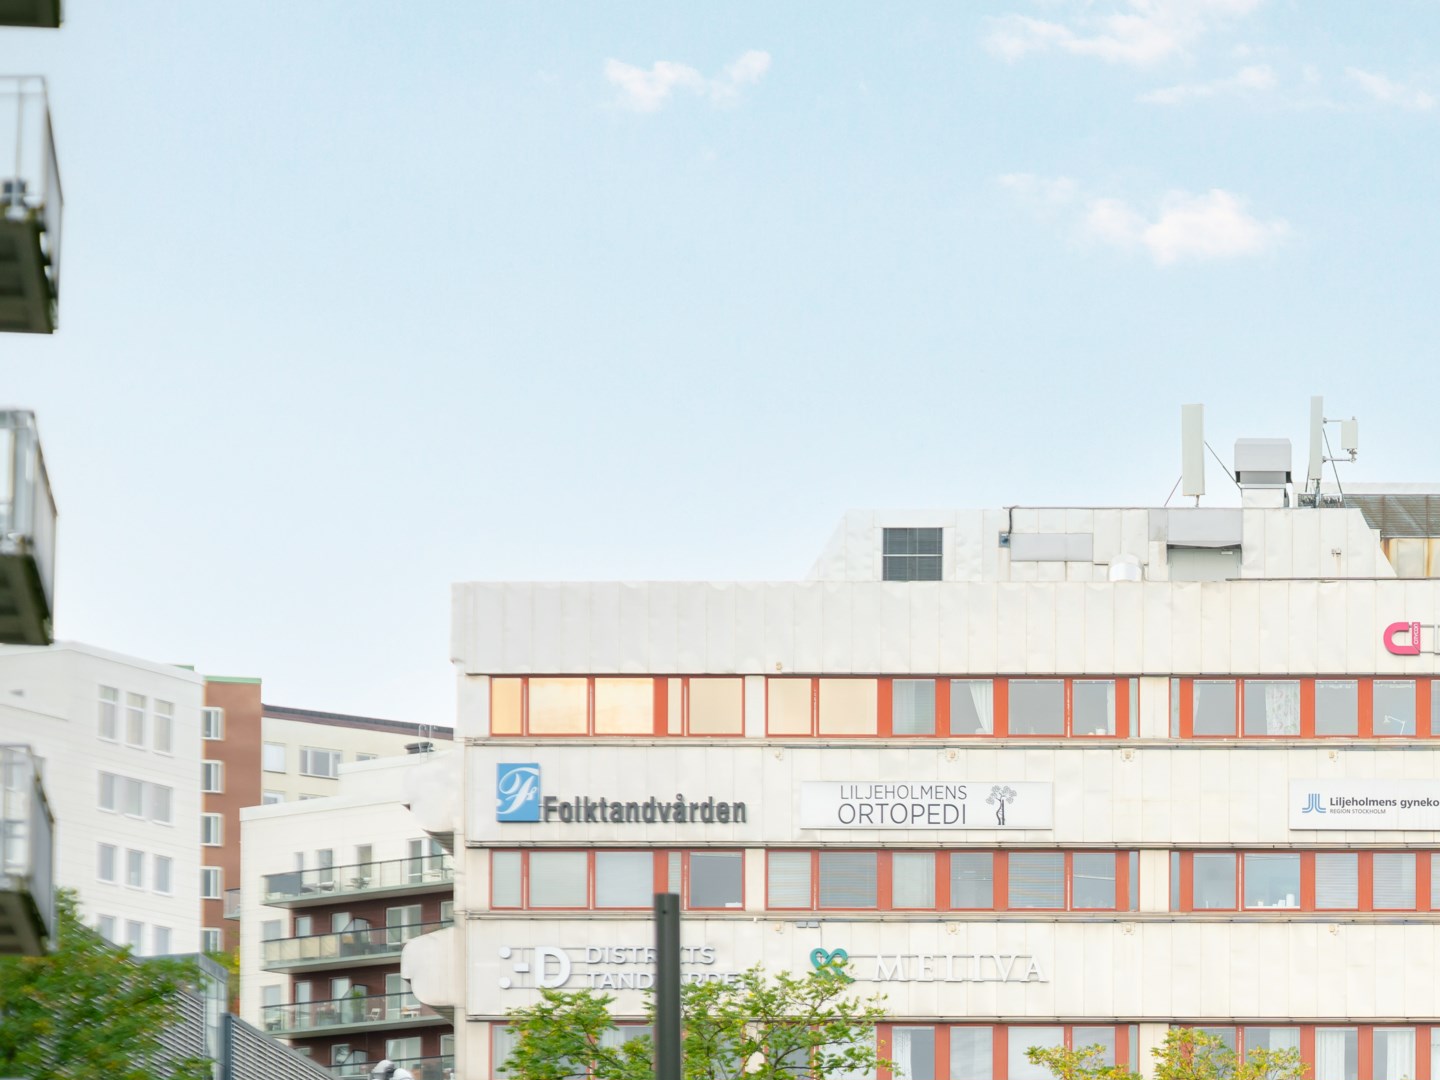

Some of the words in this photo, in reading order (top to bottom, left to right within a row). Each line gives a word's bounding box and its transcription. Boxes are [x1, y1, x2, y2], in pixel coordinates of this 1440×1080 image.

[840, 785, 967, 800] LILJEHOLMENS
[1329, 796, 1397, 808] Liljeholmens
[542, 793, 747, 824] Folktandvården
[838, 803, 966, 825] ORTOPEDI
[872, 953, 1049, 983] MELIVA
